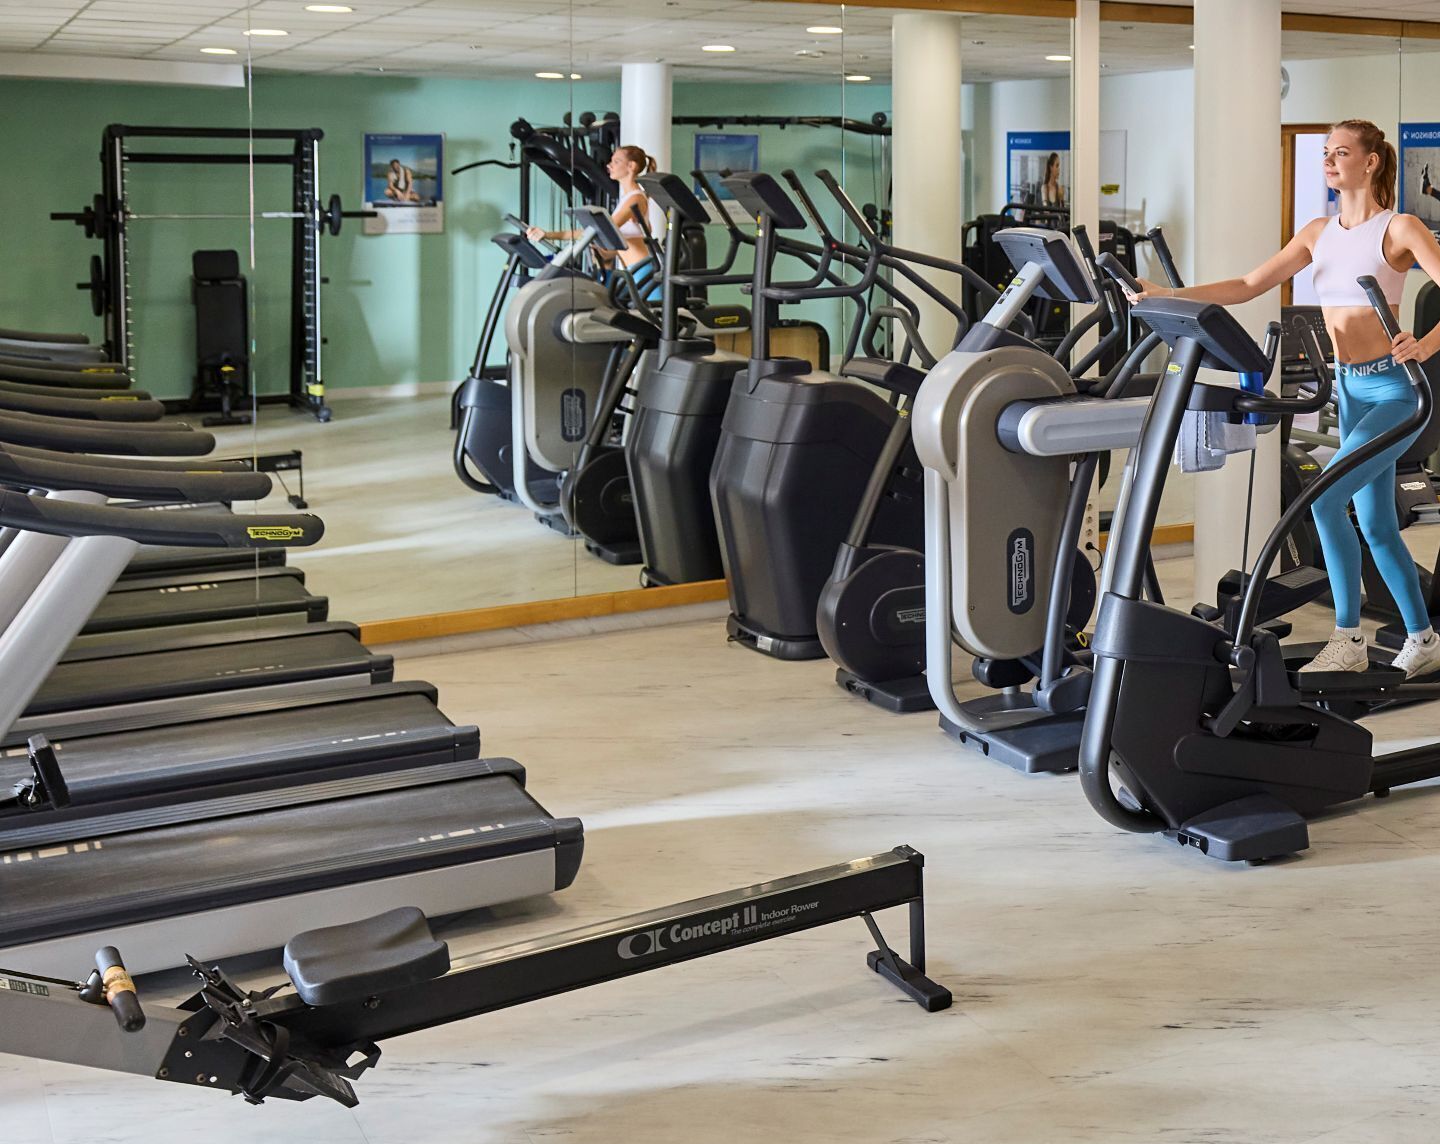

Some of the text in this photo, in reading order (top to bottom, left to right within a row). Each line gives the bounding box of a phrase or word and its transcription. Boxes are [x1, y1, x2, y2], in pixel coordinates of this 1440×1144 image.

[1352, 359, 1389, 377] NIKE
[669, 900, 820, 943] Concept II Indoor Rower
